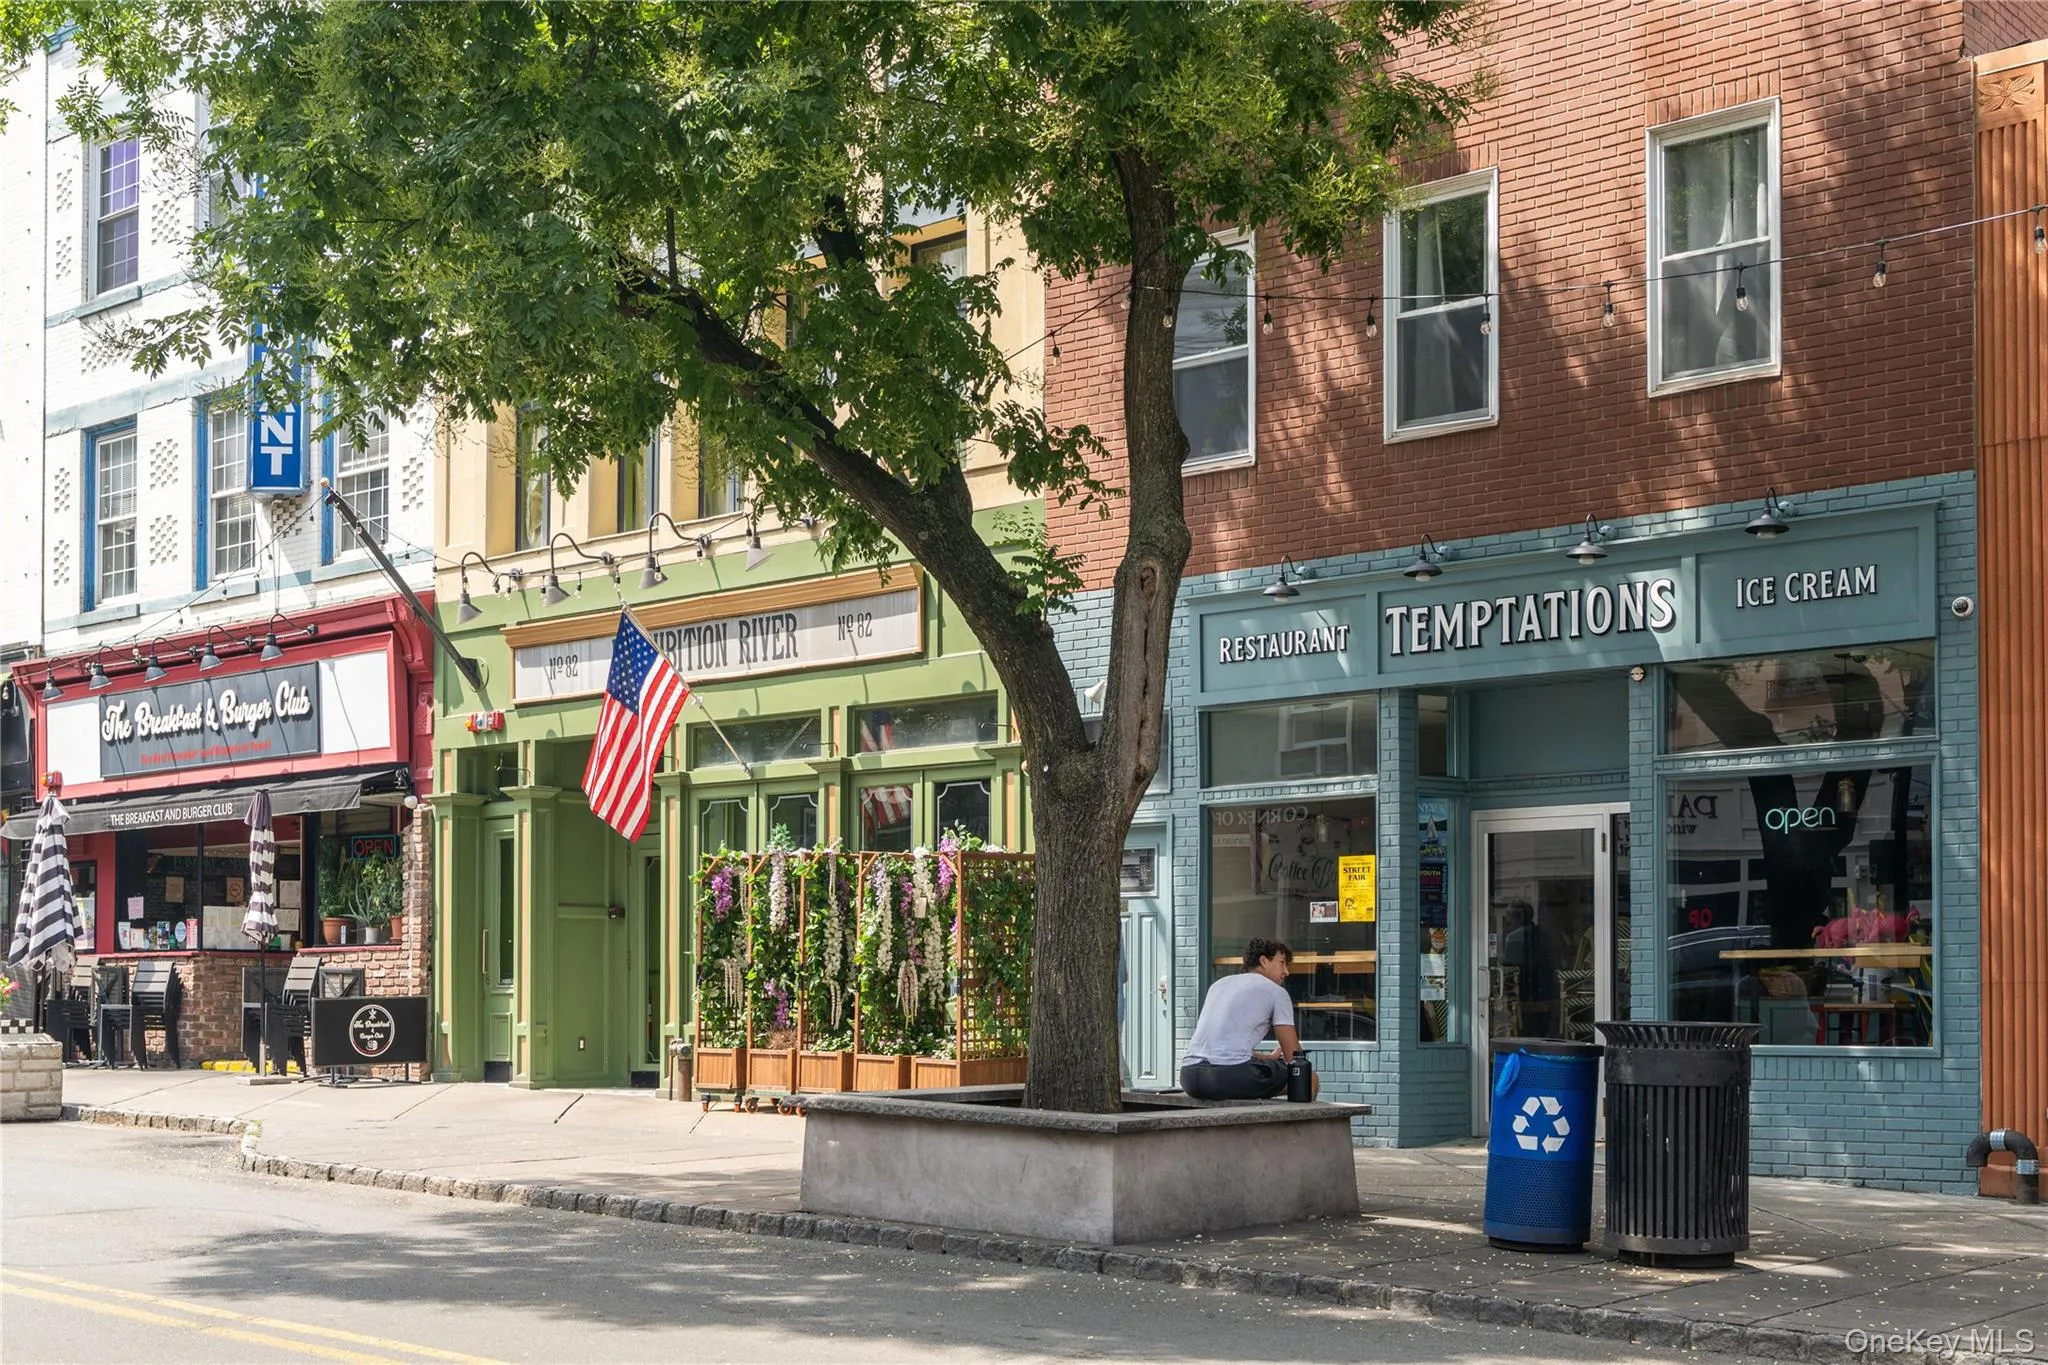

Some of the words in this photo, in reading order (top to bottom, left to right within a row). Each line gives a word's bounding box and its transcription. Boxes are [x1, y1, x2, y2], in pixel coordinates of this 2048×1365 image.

[1736, 575, 1775, 609] ICE
[1784, 564, 1878, 603] CREAM
[857, 611, 873, 638] 82
[1385, 577, 1677, 657] TEMPTATIONS
[738, 613, 799, 665] RIVER
[1218, 623, 1350, 665] RESTAURANT
[565, 654, 578, 678] 82
[101, 699, 133, 743] The
[134, 700, 203, 737] Breakfast
[205, 698, 220, 731] &
[219, 689, 273, 733] Burger
[274, 679, 311, 717] Club
[110, 813, 125, 826] THE
[125, 809, 164, 825] BREAKFAST
[164, 808, 182, 821] AND
[182, 804, 213, 820] BURGER
[212, 802, 233, 816] CLUB
[1765, 806, 1836, 835] open
[353, 839, 394, 857] OPEN
[1343, 866, 1371, 874] STREET
